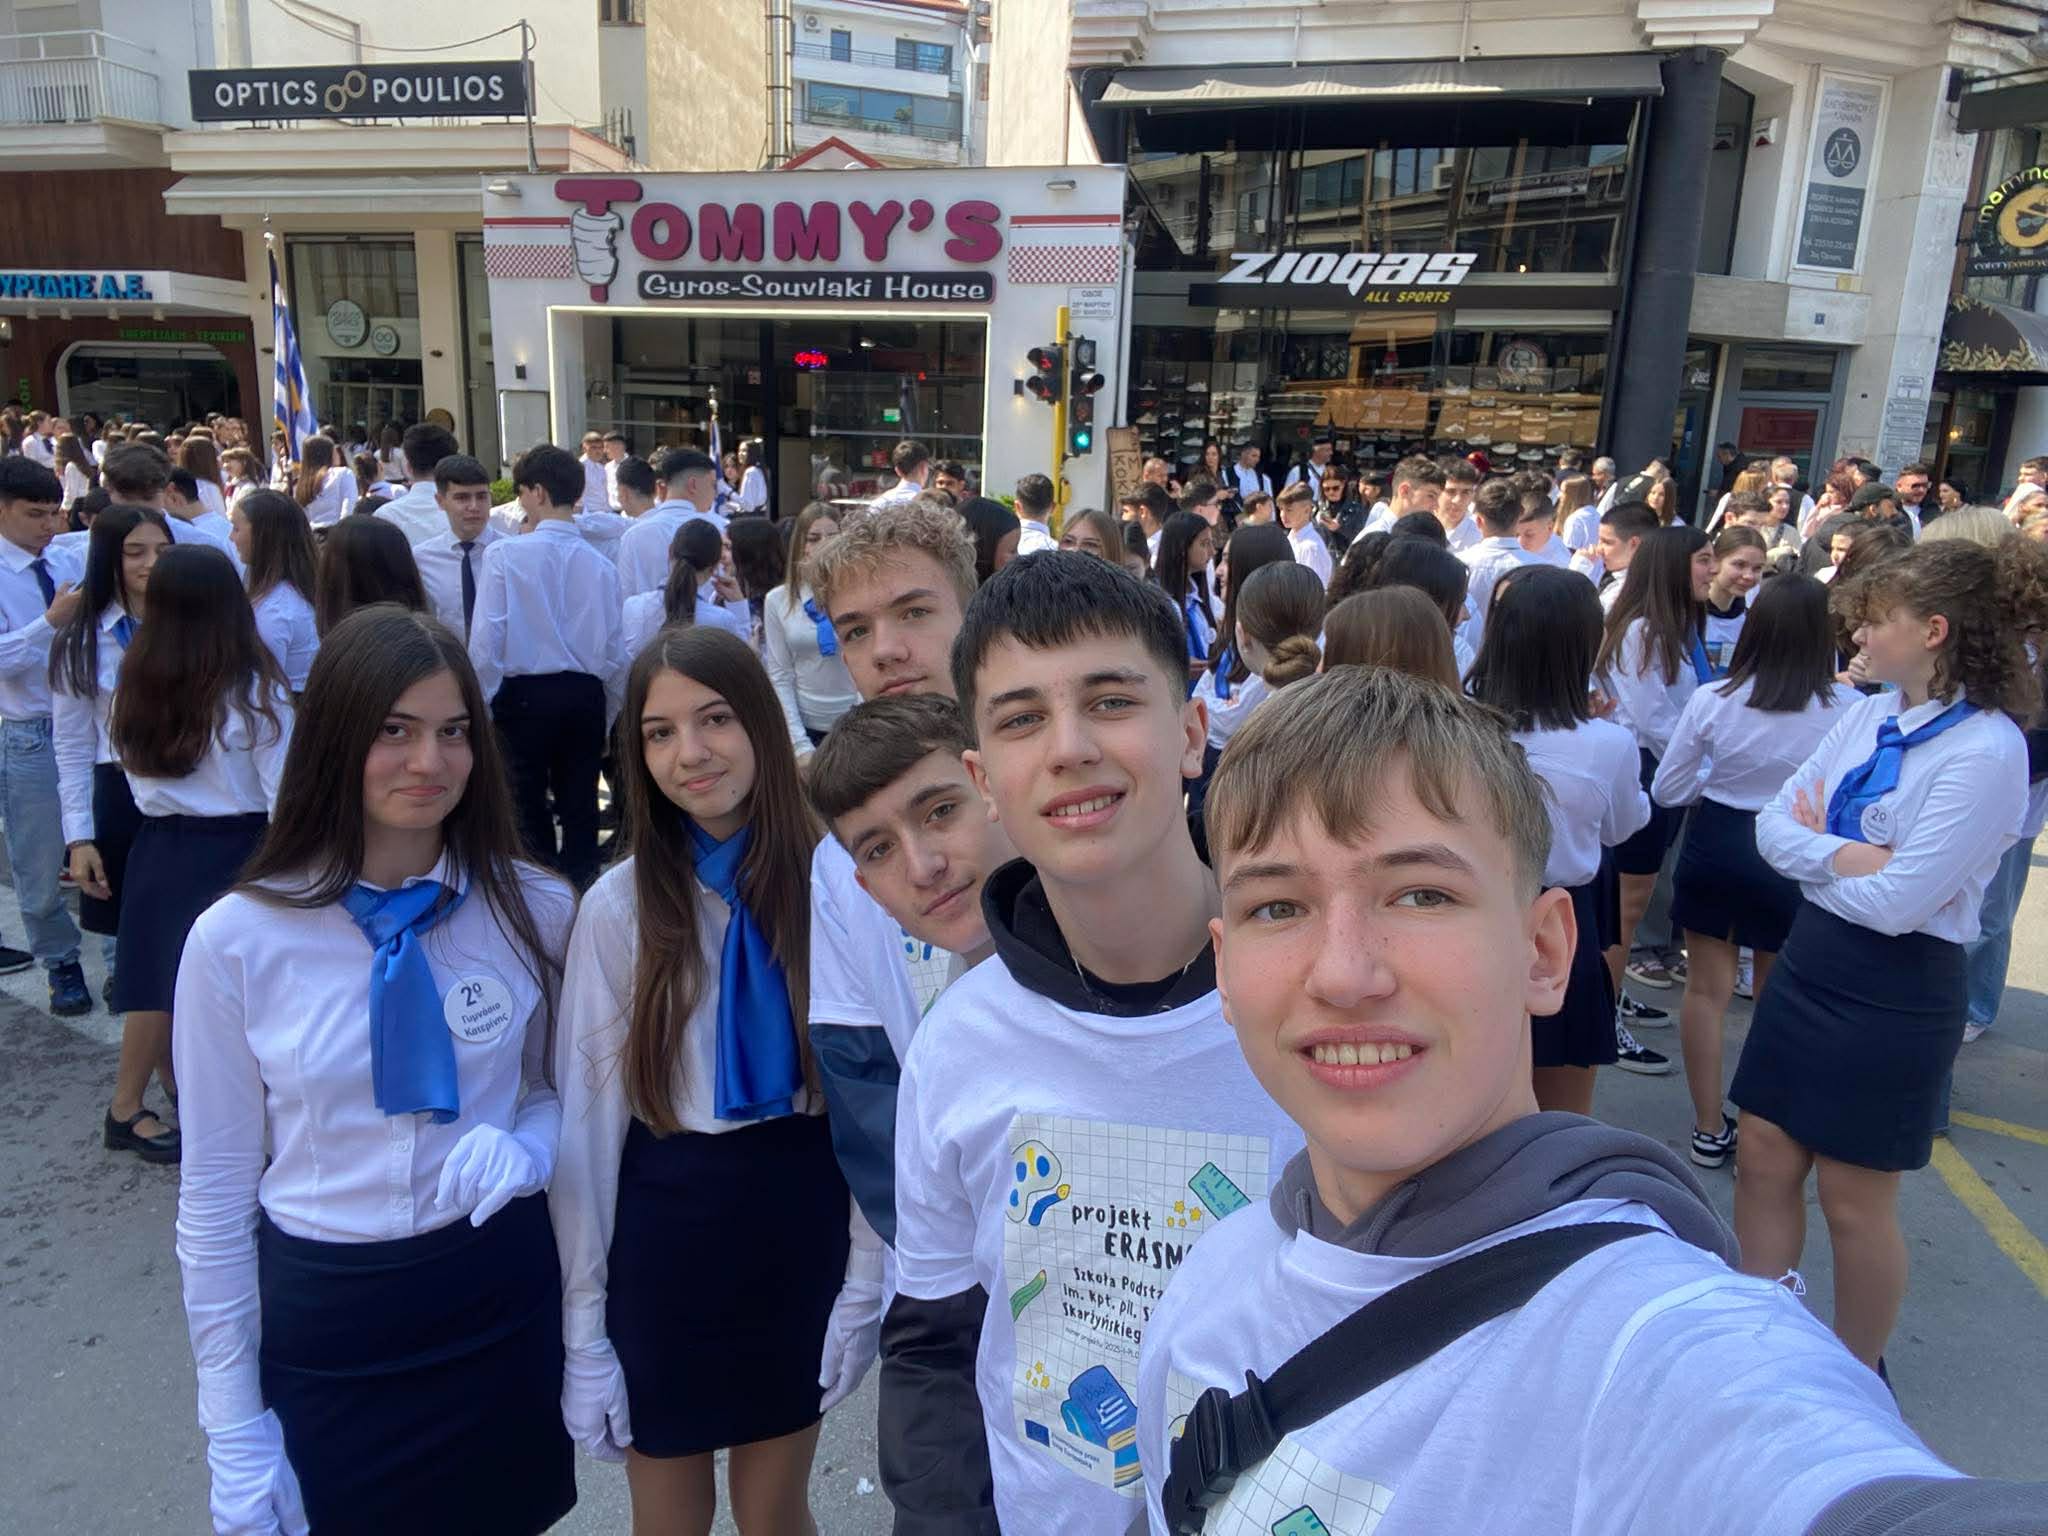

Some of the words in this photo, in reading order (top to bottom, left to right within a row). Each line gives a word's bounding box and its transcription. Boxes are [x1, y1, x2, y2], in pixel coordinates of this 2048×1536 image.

[214, 80, 317, 107] OPTICS
[373, 75, 504, 103] POULIOS
[554, 179, 1003, 302] TOMMY'S
[644, 273, 871, 300] Gyros-Souvlaki
[885, 276, 986, 299] House
[1364, 292, 1388, 303] ALL
[1397, 291, 1451, 303] SPORTS
[461, 1002, 501, 1023] Γυμνάσιο
[464, 1012, 508, 1037] Κατερίνης
[1072, 1204, 1152, 1231] projekt
[1104, 1231, 1193, 1270] ERASM
[1073, 1267, 1116, 1288] Szkoła
[1063, 1282, 1084, 1300] im.
[1088, 1289, 1115, 1310] kpt.
[1120, 1300, 1137, 1319] pil.
[1143, 1306, 1153, 1322] S
[1063, 1302, 1141, 1344] Skarżyńskieg
